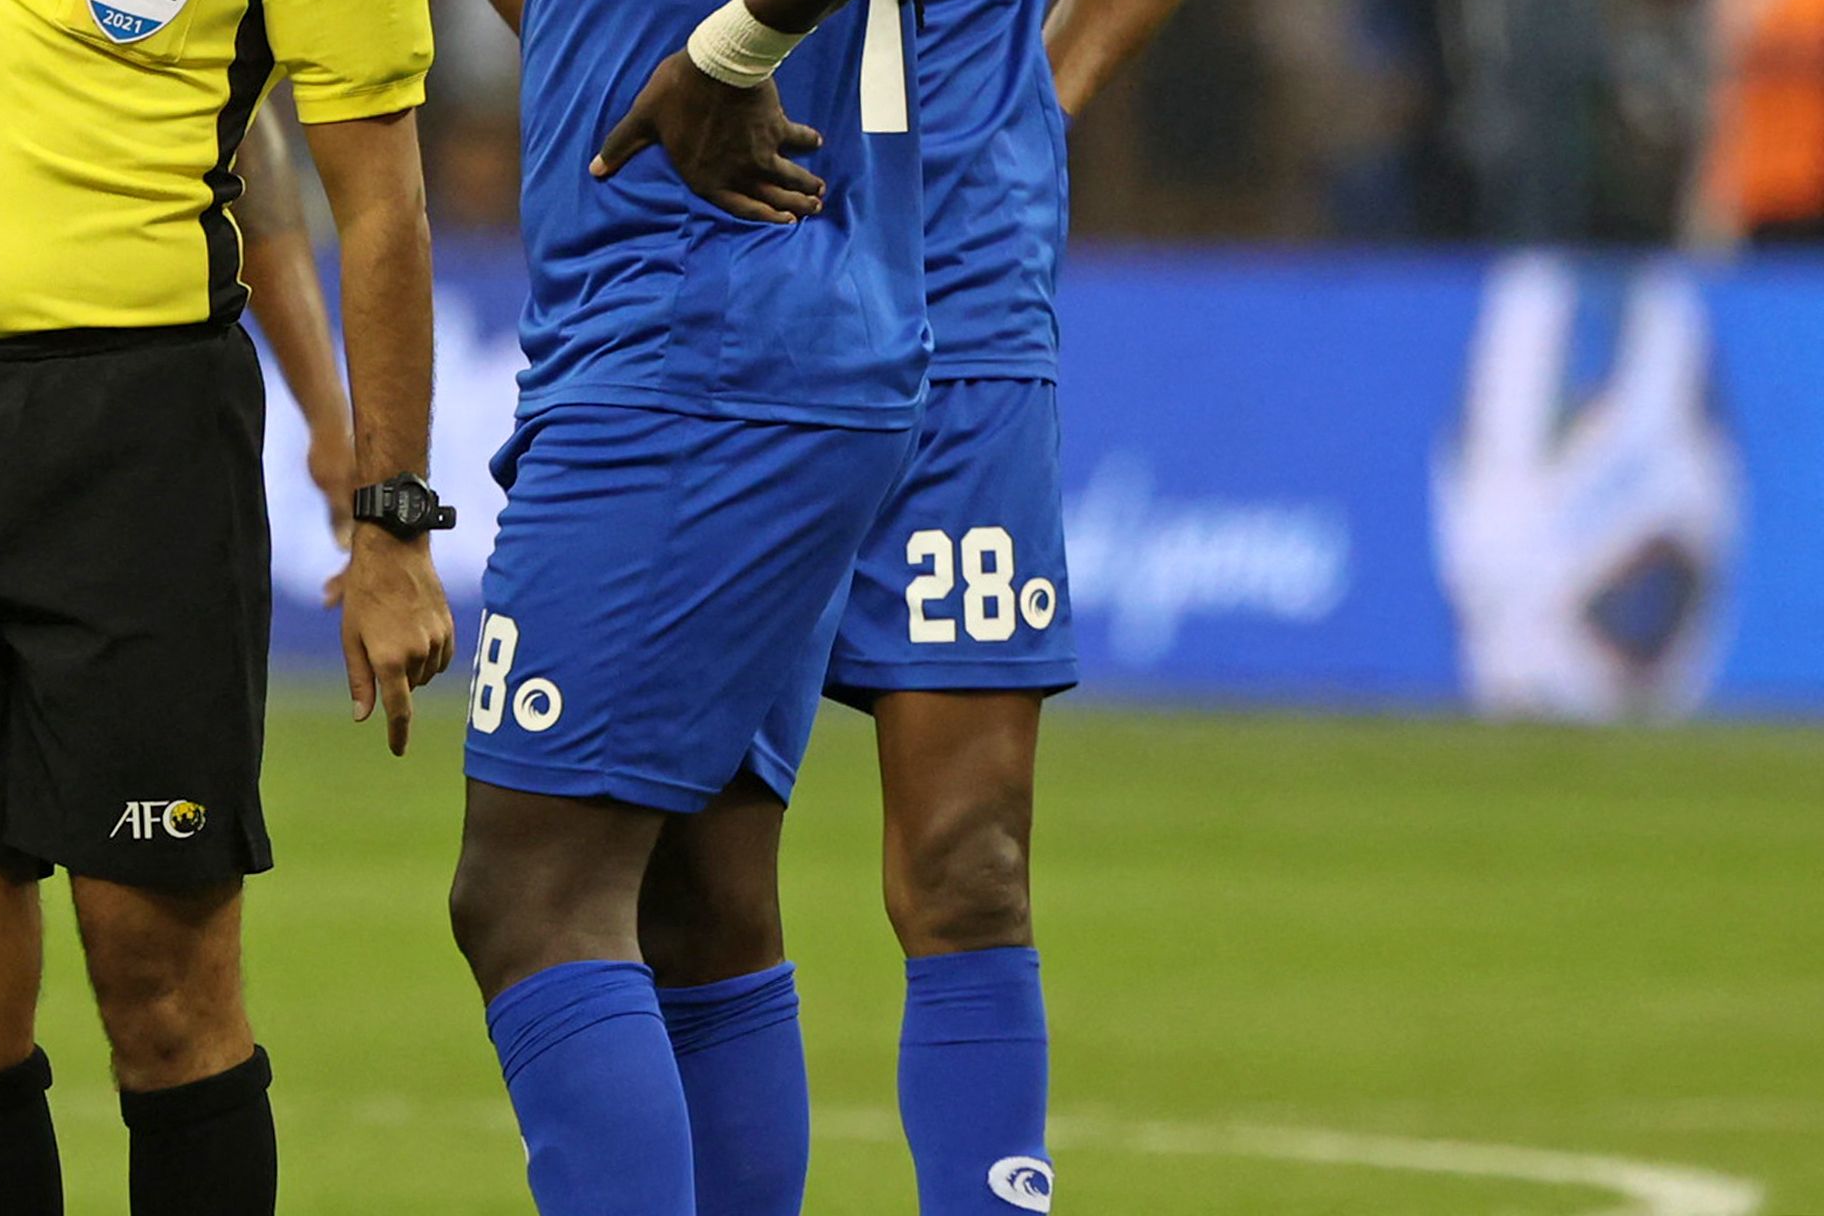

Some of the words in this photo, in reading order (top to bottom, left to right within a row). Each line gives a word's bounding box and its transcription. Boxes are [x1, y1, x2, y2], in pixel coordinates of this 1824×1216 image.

[102, 10, 143, 34] 2021
[906, 527, 1016, 643] 28
[467, 608, 519, 734] 8
[109, 799, 206, 839] AFC
